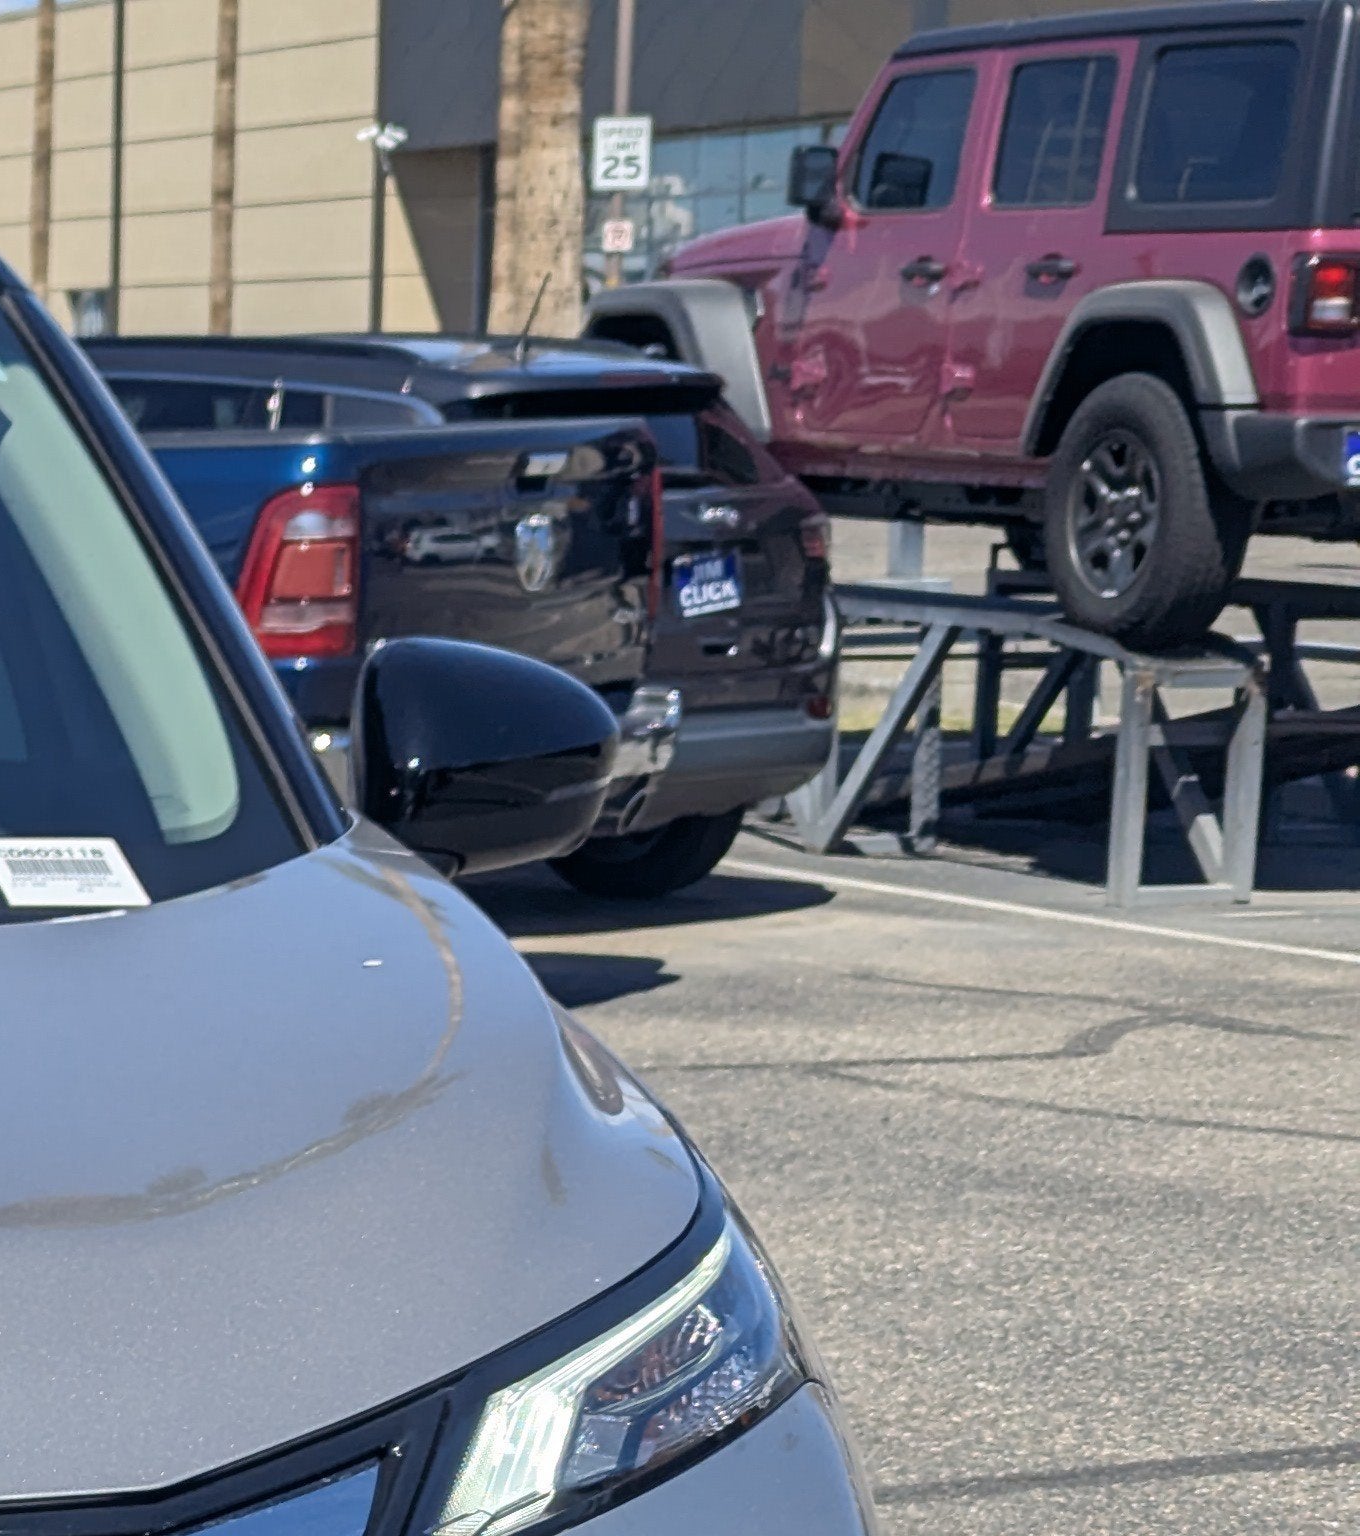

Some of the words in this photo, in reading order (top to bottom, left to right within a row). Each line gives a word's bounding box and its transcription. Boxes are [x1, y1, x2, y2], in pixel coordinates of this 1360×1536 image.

[600, 127, 643, 138] SPEED
[603, 140, 641, 151] LIMIT
[601, 155, 642, 181] 25
[691, 560, 724, 584] JIM
[679, 580, 738, 608] CLICK
